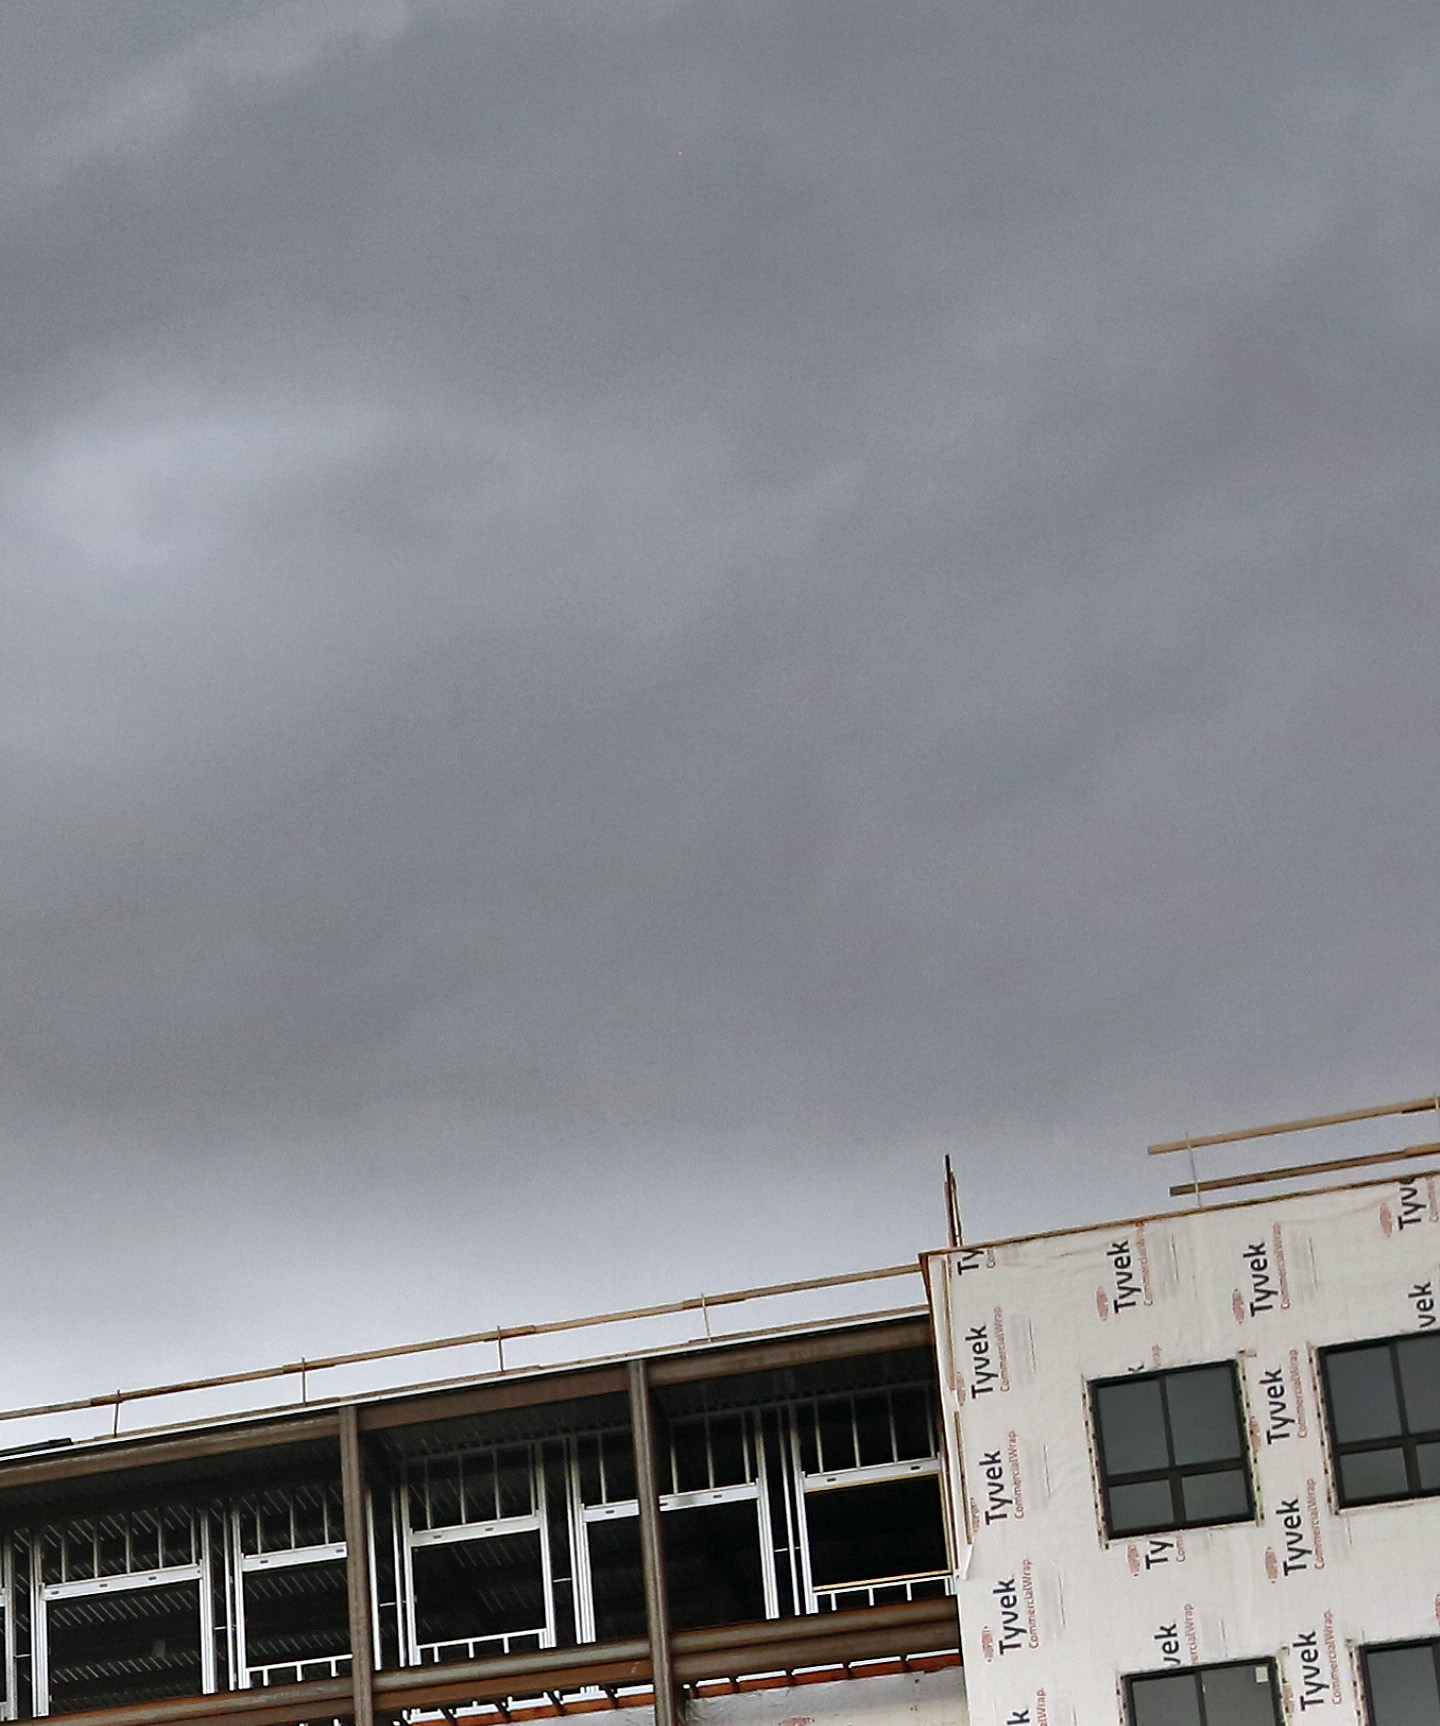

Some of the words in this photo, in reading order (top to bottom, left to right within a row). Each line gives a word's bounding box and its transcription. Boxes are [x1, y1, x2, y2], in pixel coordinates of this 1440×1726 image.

[1107, 1240, 1141, 1314] Tyvek
[1243, 1243, 1279, 1317] Tyvek
[1408, 1281, 1436, 1327] vek
[965, 1325, 999, 1399] Tyvek
[1259, 1369, 1295, 1445] Tyvek
[979, 1450, 1013, 1526] Tyvek
[1276, 1499, 1312, 1576] Tyvek
[993, 1578, 1027, 1655] Tyvek
[1293, 1632, 1329, 1711] Tyvek
